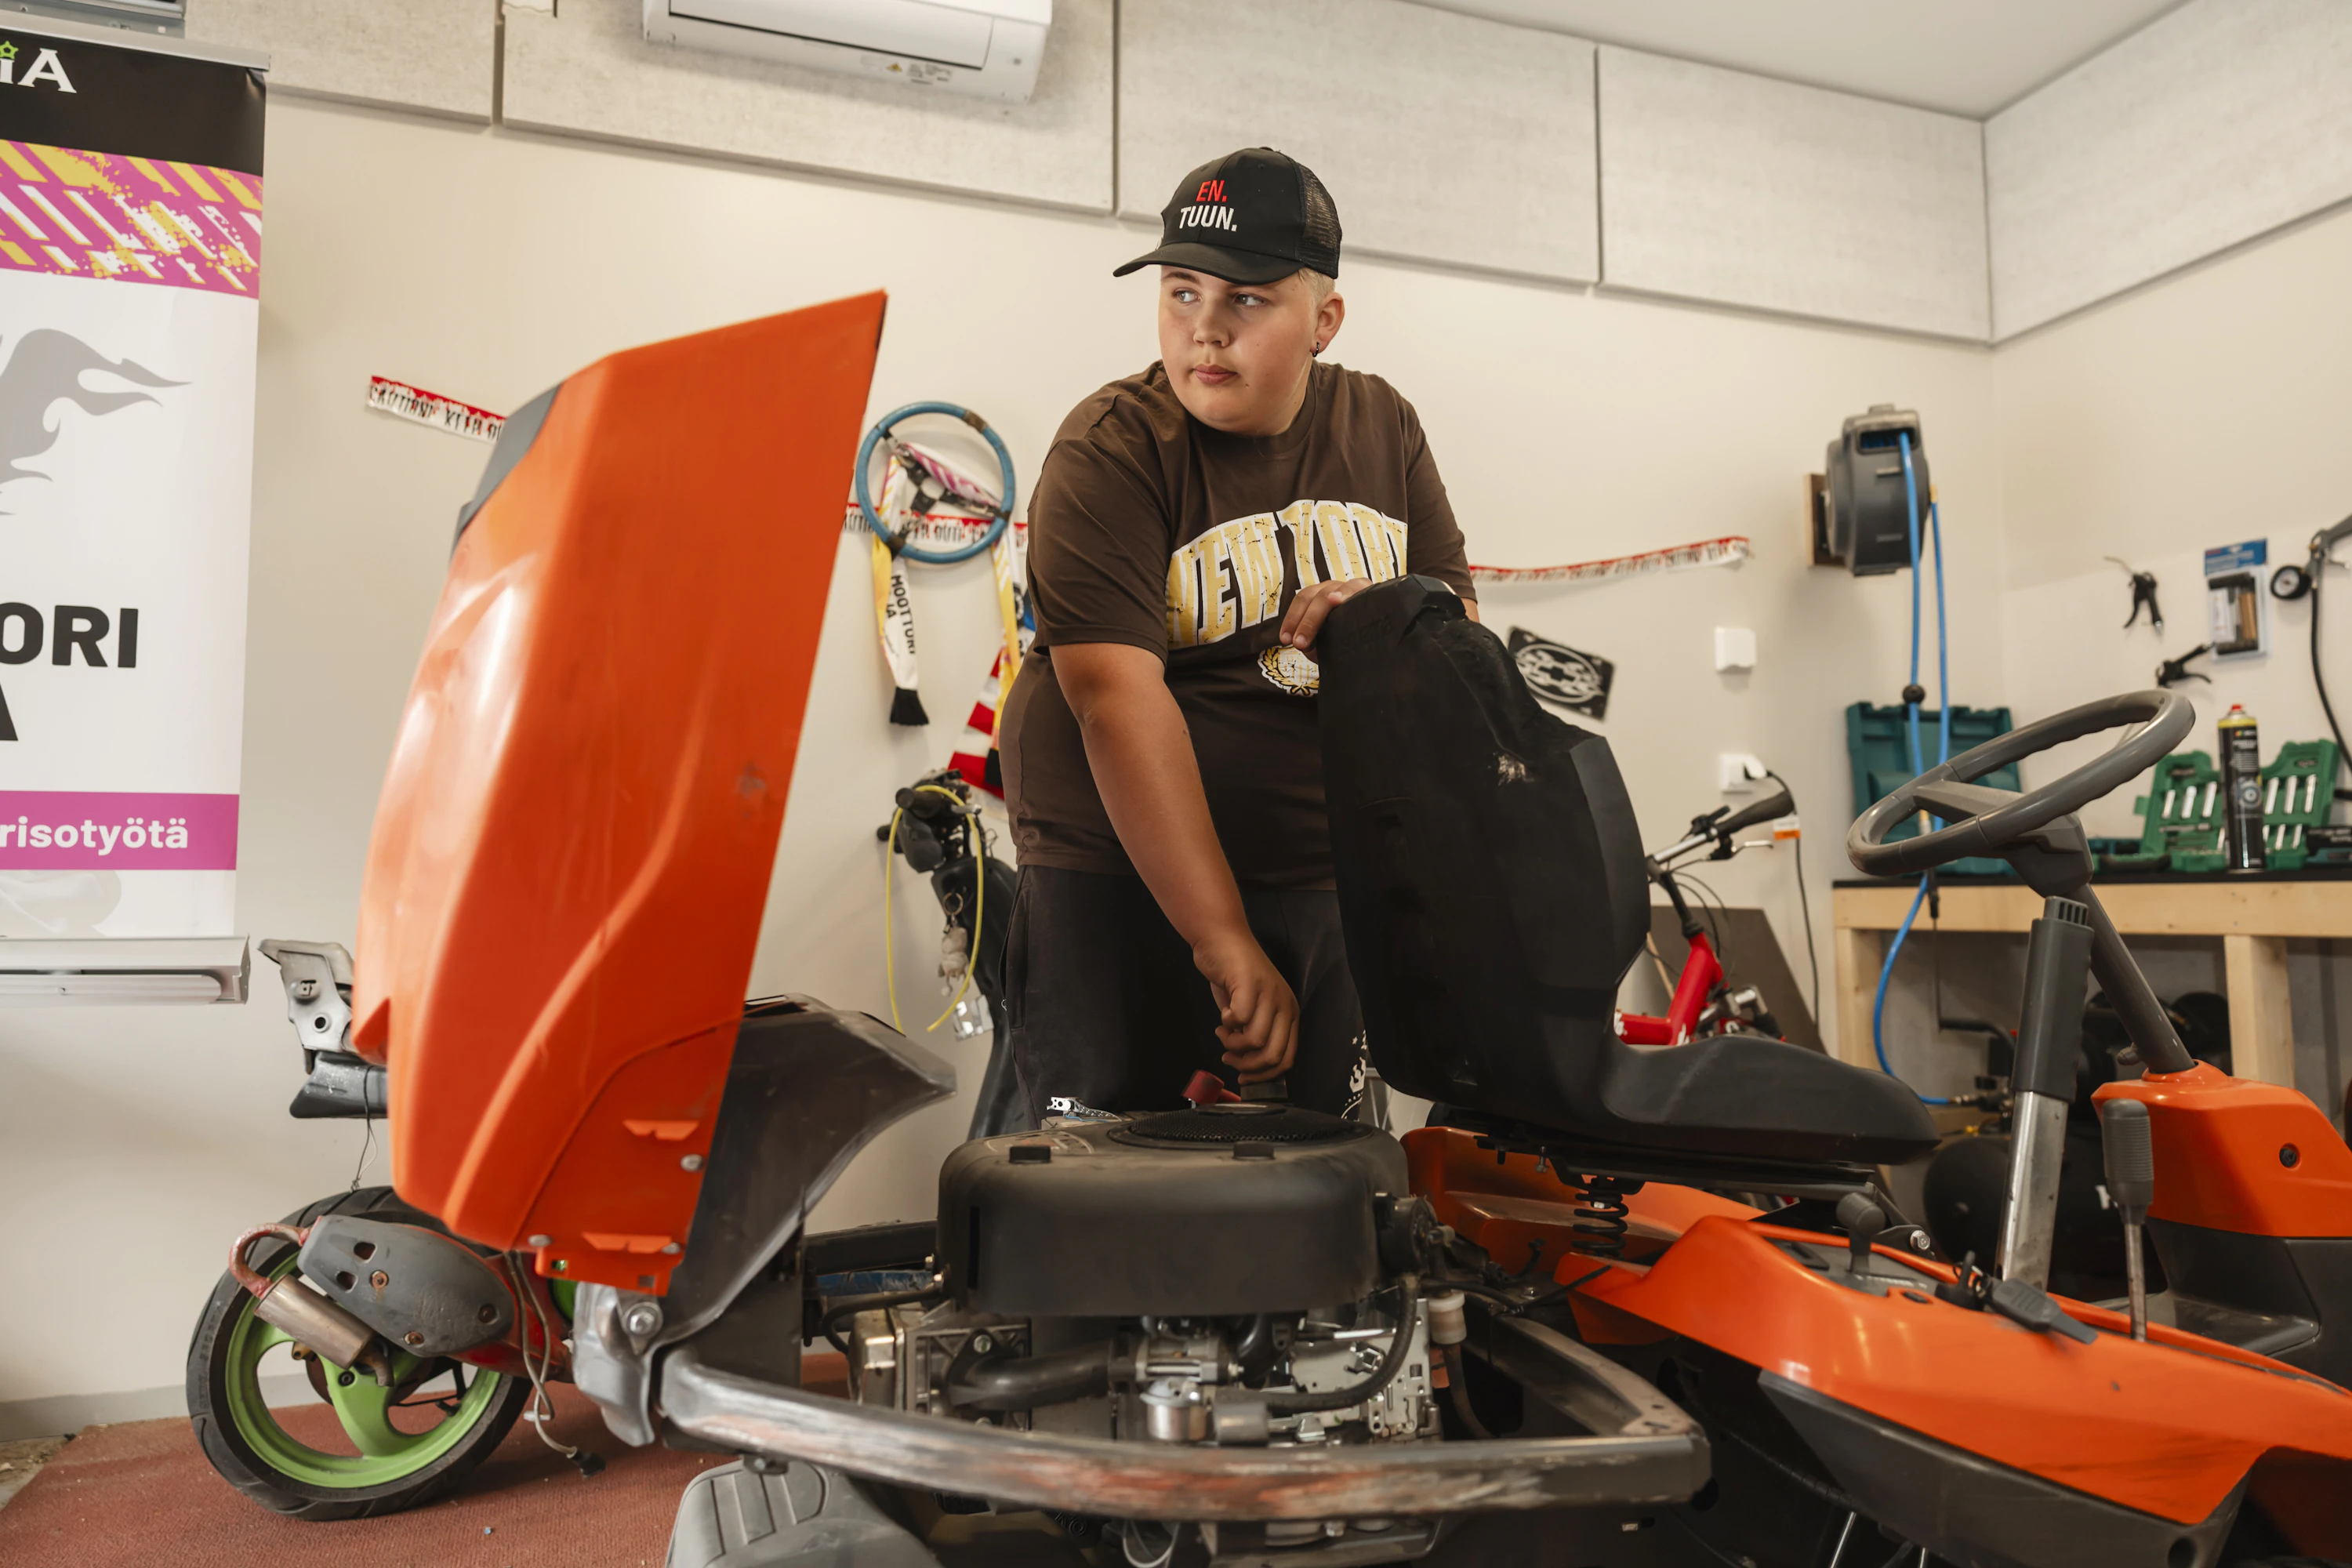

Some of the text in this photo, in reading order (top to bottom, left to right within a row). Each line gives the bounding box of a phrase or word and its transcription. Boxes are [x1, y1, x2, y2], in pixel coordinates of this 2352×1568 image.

[1196, 180, 1228, 202] EN.
[1178, 204, 1238, 233] TUUN.
[1165, 511, 1285, 652] NEW
[0, 601, 140, 669] ORI
[0, 815, 189, 857] risotyötä
